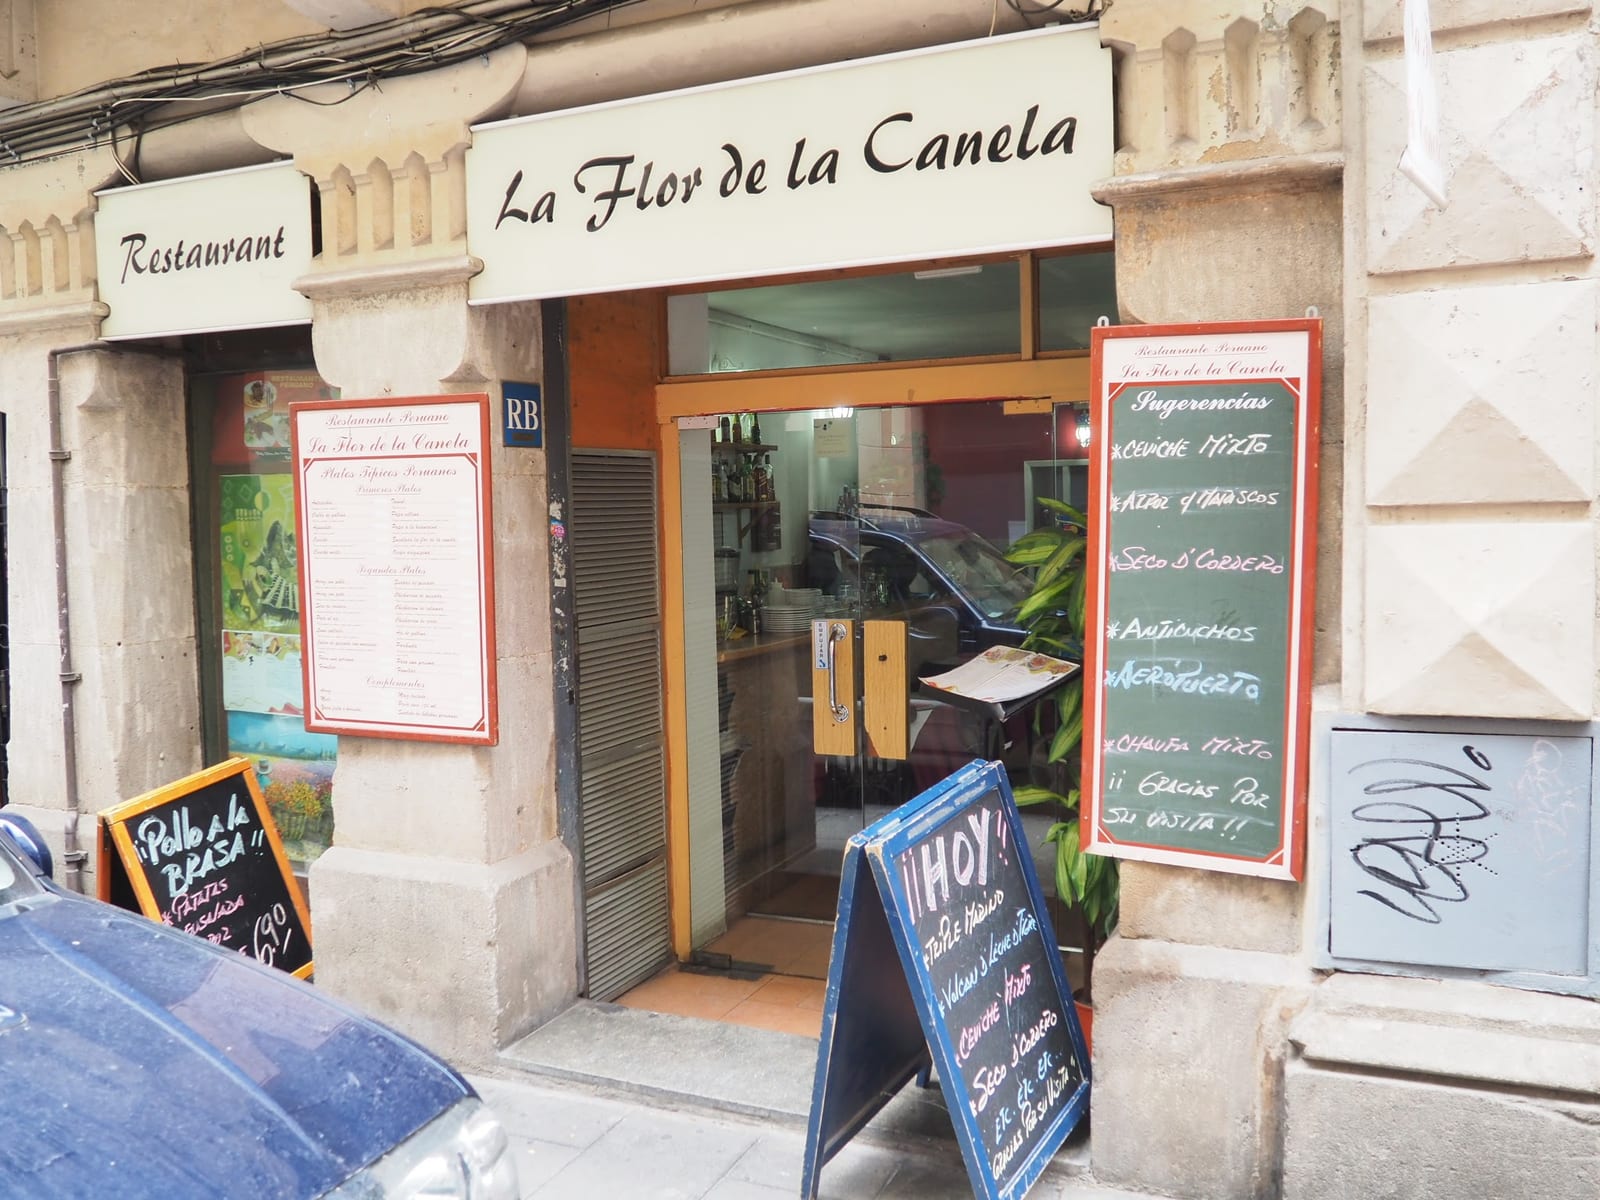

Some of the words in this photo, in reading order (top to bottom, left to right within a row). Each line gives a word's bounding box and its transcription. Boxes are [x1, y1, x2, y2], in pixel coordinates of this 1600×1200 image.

[495, 169, 556, 231] La
[573, 154, 702, 233] Flor
[719, 143, 767, 198] de
[786, 137, 840, 190] la
[863, 103, 1078, 174] Canela
[120, 226, 285, 284] Restaurant
[1134, 342, 1209, 357] Restaurante
[1214, 343, 1268, 353] Peruano
[1121, 365, 1140, 378] La
[1146, 362, 1179, 377] Flor
[1184, 361, 1201, 376] de
[1206, 361, 1221, 375] la
[1226, 359, 1287, 374] Canela
[325, 411, 394, 426] Restaurante
[400, 410, 449, 422] Peruano
[506, 398, 539, 431] RB
[308, 436, 327, 453] La
[333, 436, 364, 453] Flor
[369, 436, 385, 451] de
[391, 435, 406, 451] la
[412, 432, 470, 450] Canela
[320, 466, 354, 479] Platos
[402, 463, 457, 477] Peruanos
[161, 832, 246, 898] BRASA
